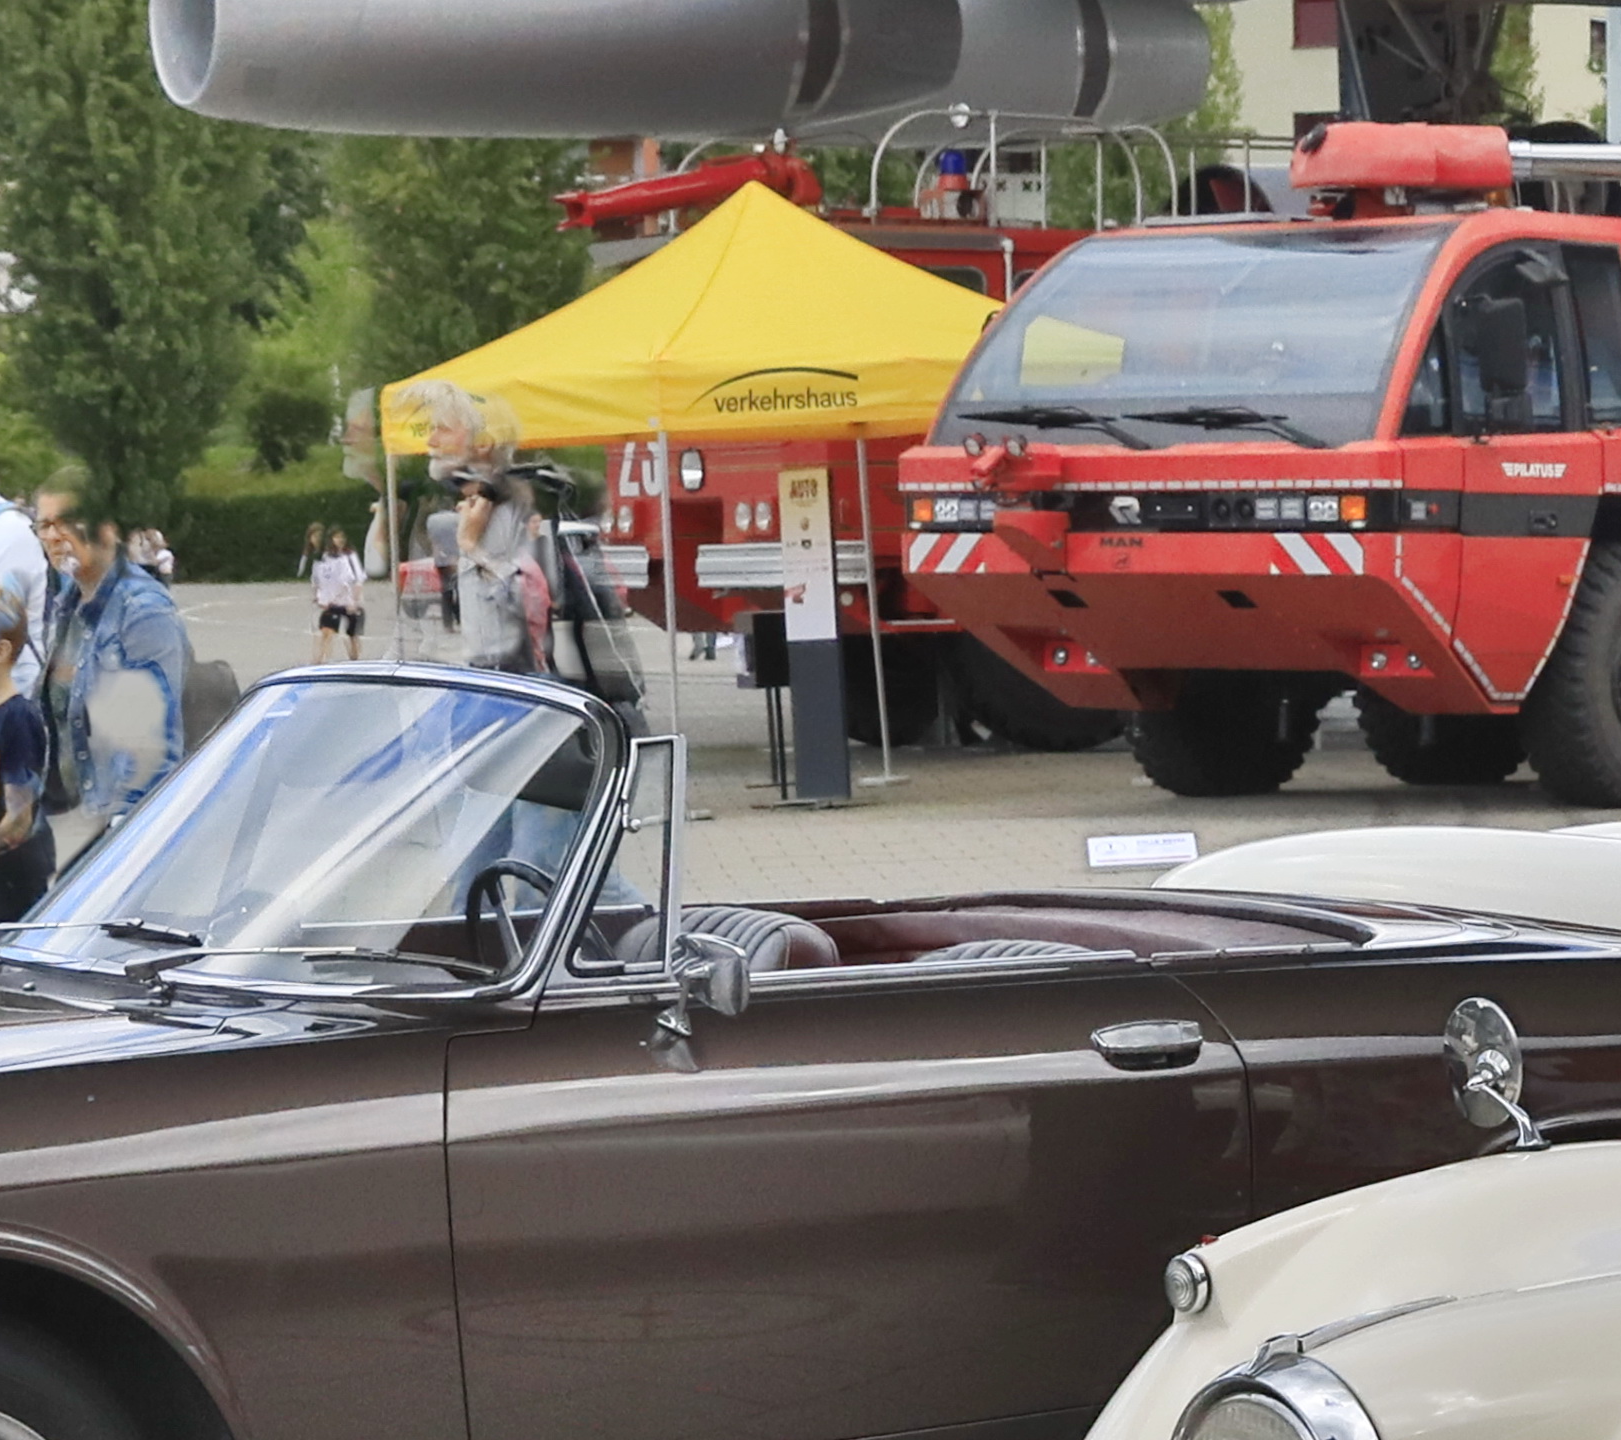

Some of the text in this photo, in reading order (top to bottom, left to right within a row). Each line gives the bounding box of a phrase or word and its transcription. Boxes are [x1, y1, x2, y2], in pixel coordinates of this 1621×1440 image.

[713, 387, 858, 414] verkehrshaus
[1512, 463, 1557, 478] PILATUS
[1099, 536, 1143, 548] MAN
